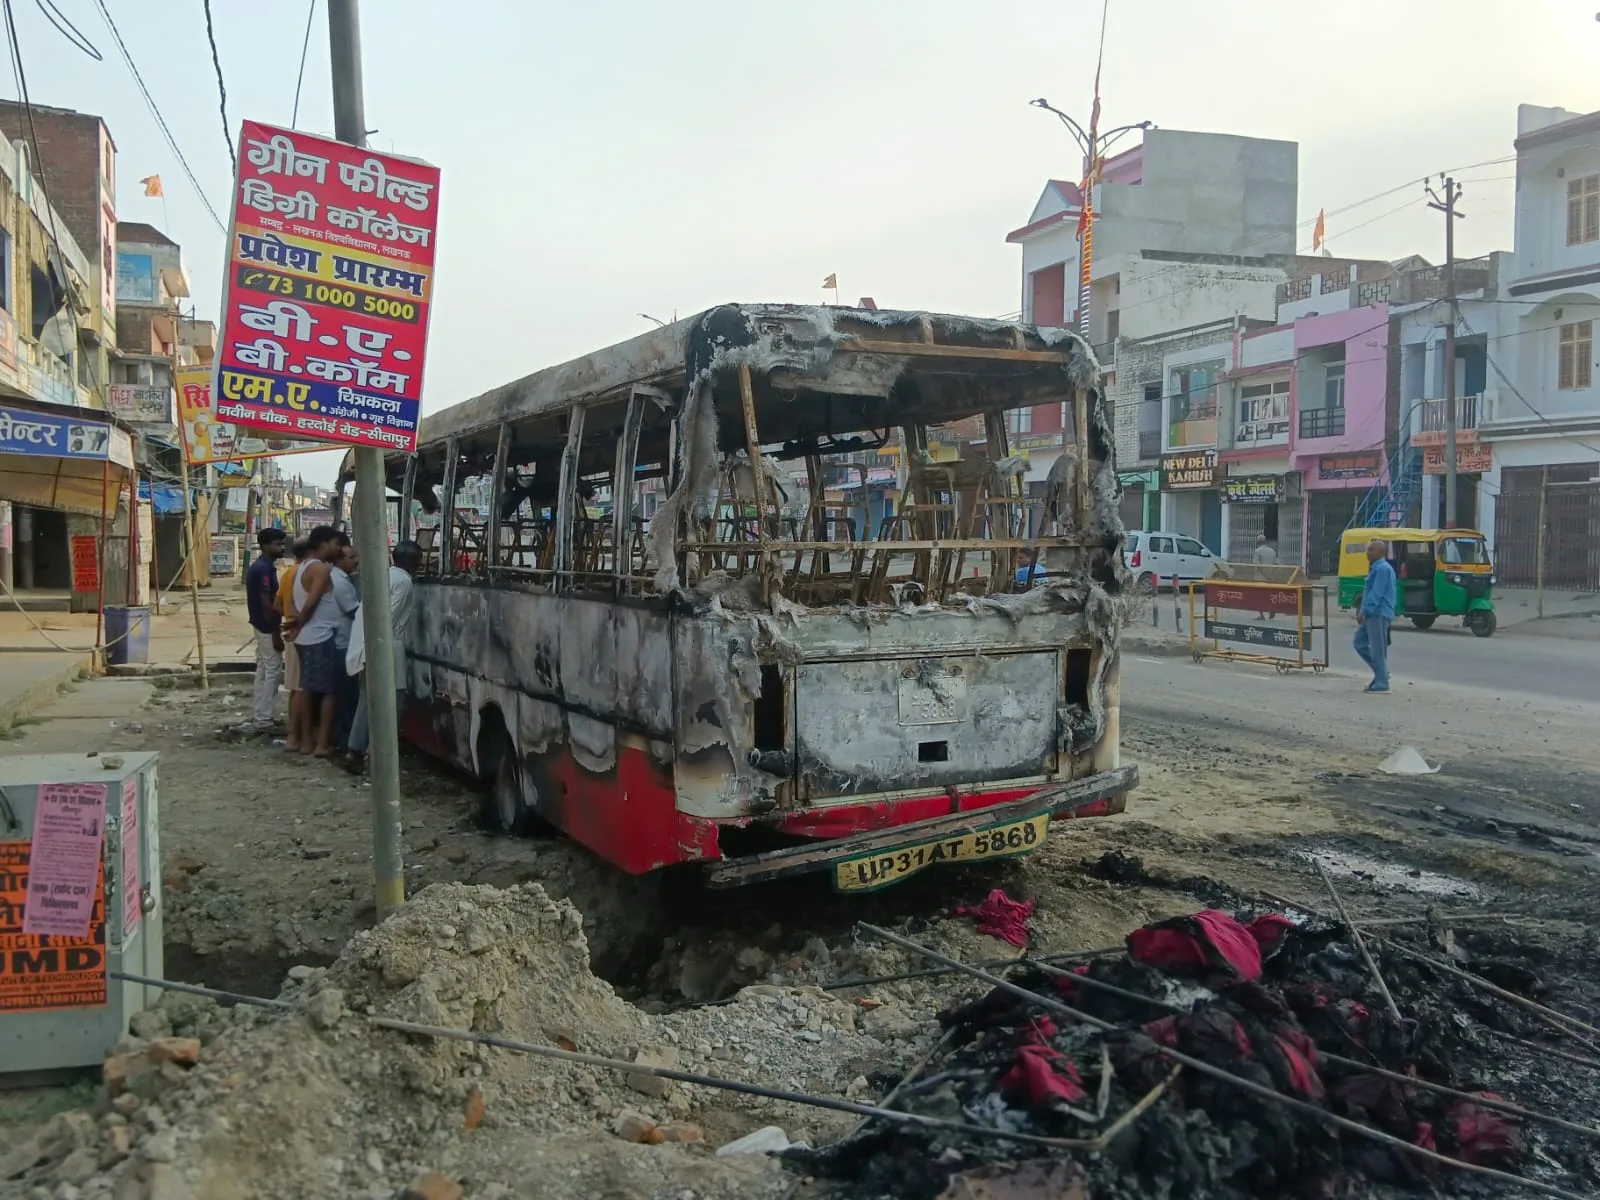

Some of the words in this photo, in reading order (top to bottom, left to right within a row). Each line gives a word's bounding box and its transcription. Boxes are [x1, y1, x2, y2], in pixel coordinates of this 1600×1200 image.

[247, 134, 329, 184] ग्रीन
[338, 158, 434, 211] फील्ड
[241, 179, 319, 221] डिग्री
[326, 204, 431, 248] कॉलेज
[293, 224, 323, 239] लखनऊ
[382, 245, 411, 259] लखनऊ
[237, 232, 322, 274] प्रवेश
[332, 254, 426, 297] प्रारम्भ
[267, 273, 293, 294] 73
[304, 284, 355, 308] 1000
[364, 294, 414, 320] 5000
[234, 337, 411, 394] बी.कॉम
[222, 369, 320, 410] एम.ए.
[337, 387, 401, 413] चित्रकला
[218, 404, 256, 420] नवीन
[297, 417, 338, 433] हरदोई
[387, 415, 414, 429] विज्ञान
[1163, 457, 1186, 471] NEW
[857, 840, 963, 883] UP31AT
[975, 822, 1037, 854] 5868
